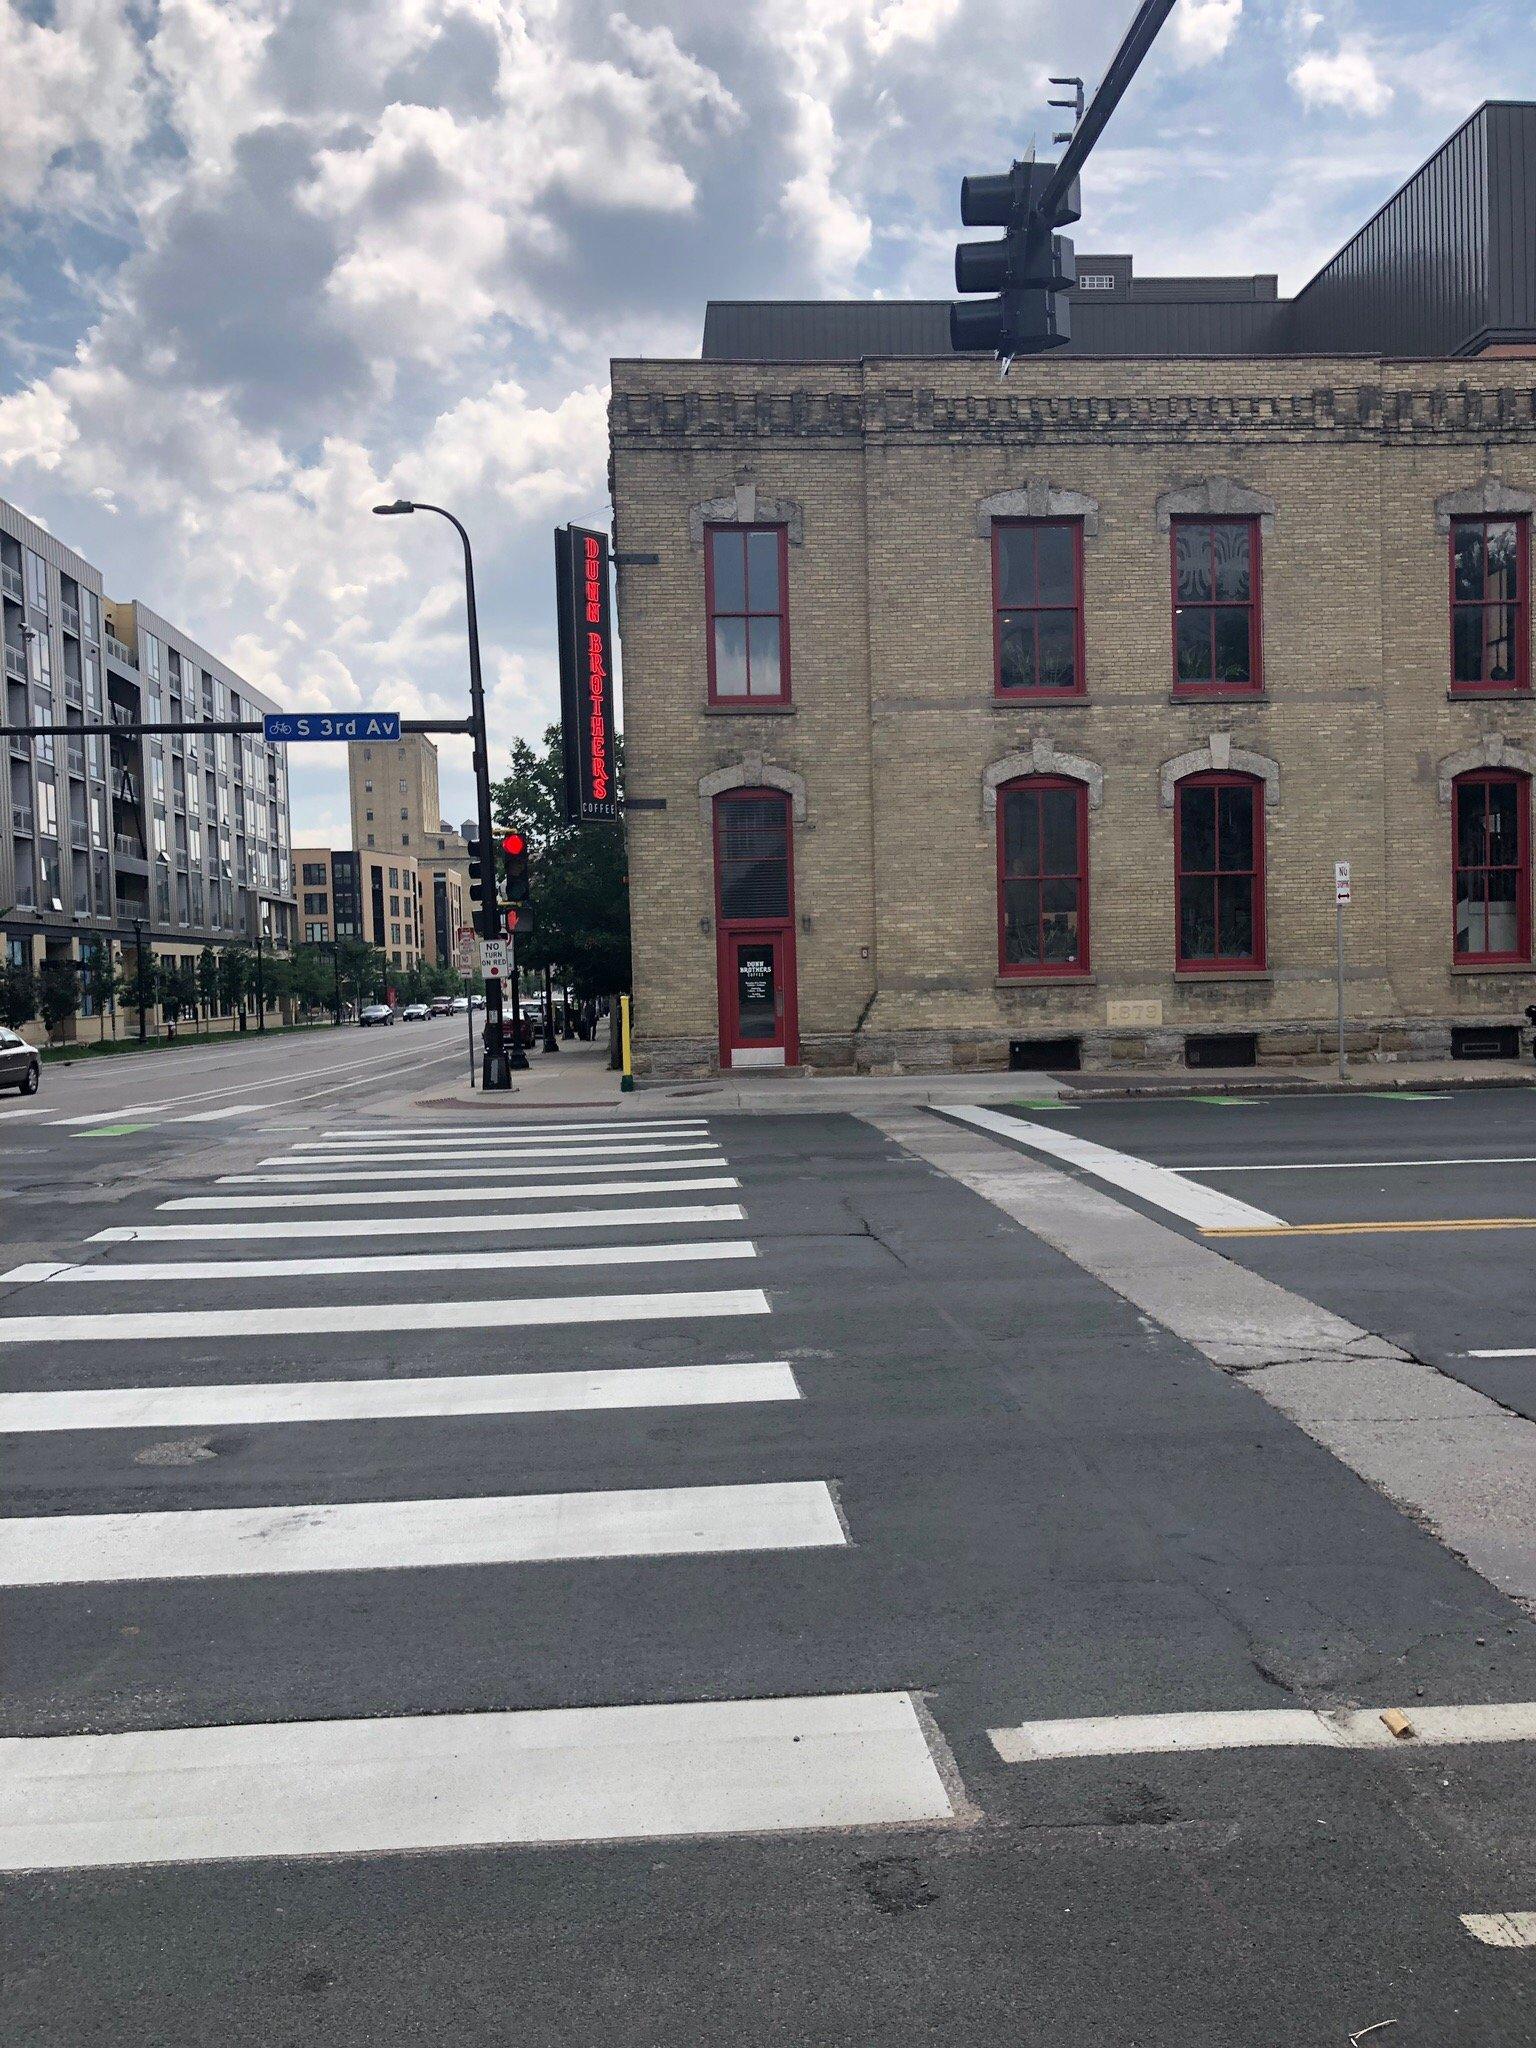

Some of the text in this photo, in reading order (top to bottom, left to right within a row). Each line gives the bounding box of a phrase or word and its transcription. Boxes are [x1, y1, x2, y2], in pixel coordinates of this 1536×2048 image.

[584, 537, 608, 799] DUNN BROTHERS
[297, 719, 394, 736] S 3rd Av
[583, 803, 614, 814] COFFEE
[1339, 866, 1348, 877] NO
[485, 951, 503, 959] TURN
[481, 959, 492, 967] ON
